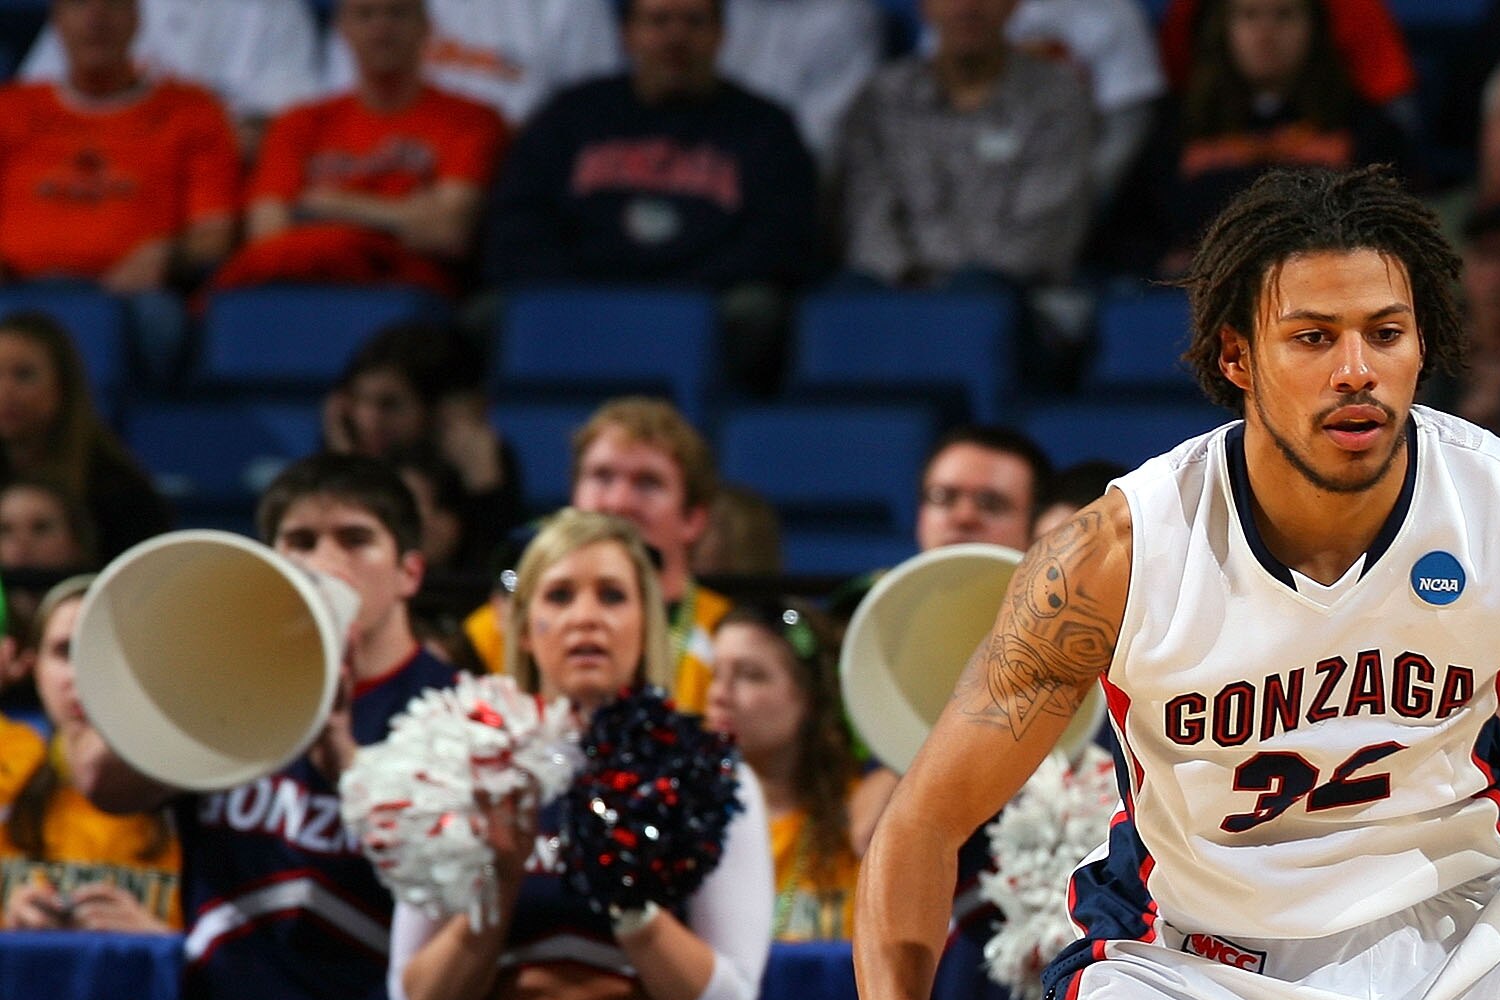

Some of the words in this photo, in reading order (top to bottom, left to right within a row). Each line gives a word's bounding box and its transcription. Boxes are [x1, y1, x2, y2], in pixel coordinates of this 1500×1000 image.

[1419, 577, 1459, 592] NCAA
[1164, 648, 1475, 747] GONZAGA
[1191, 933, 1258, 970] WCC
